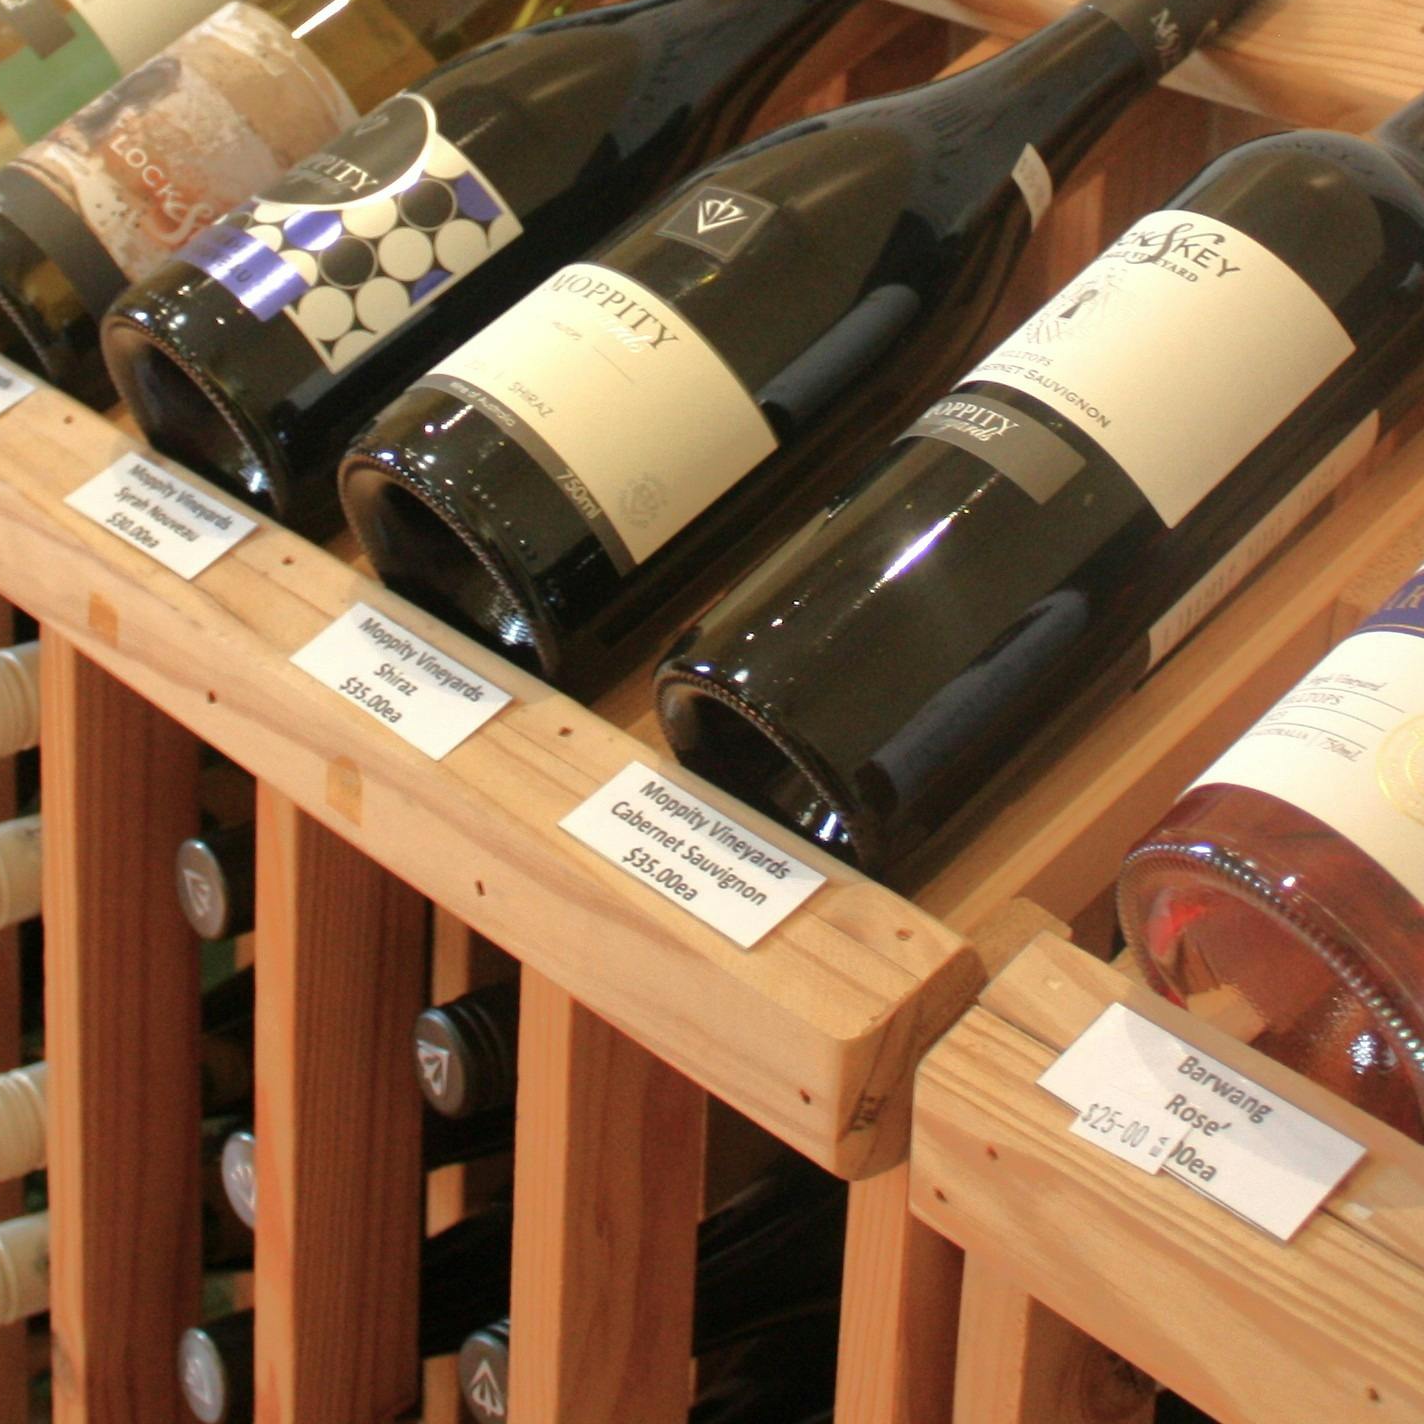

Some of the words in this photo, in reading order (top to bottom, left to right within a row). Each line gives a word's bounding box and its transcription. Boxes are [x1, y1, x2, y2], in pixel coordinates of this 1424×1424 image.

[109, 134, 176, 201] LOCK
[552, 273, 679, 350] MOPPITY
[507, 381, 554, 418] SHIRAZ
[1023, 369, 1112, 428] SAUVIGNON
[114, 486, 149, 511] Syrah
[147, 505, 201, 542] Nouveau
[129, 463, 179, 498] Moppity
[176, 490, 233, 531] Vineyards
[105, 512, 160, 549] $30.00ea
[358, 617, 417, 661] Moppity
[416, 651, 486, 703] Vineyards
[373, 662, 419, 697] Shiraz
[339, 676, 403, 724] $35.00ea
[611, 800, 685, 853] Cabernet
[681, 845, 767, 907] Sauvignon
[639, 780, 710, 830] Moppity
[709, 822, 792, 880] Vineyards
[622, 847, 698, 902] $35.00ea
[1177, 1056, 1273, 1124] Barwang
